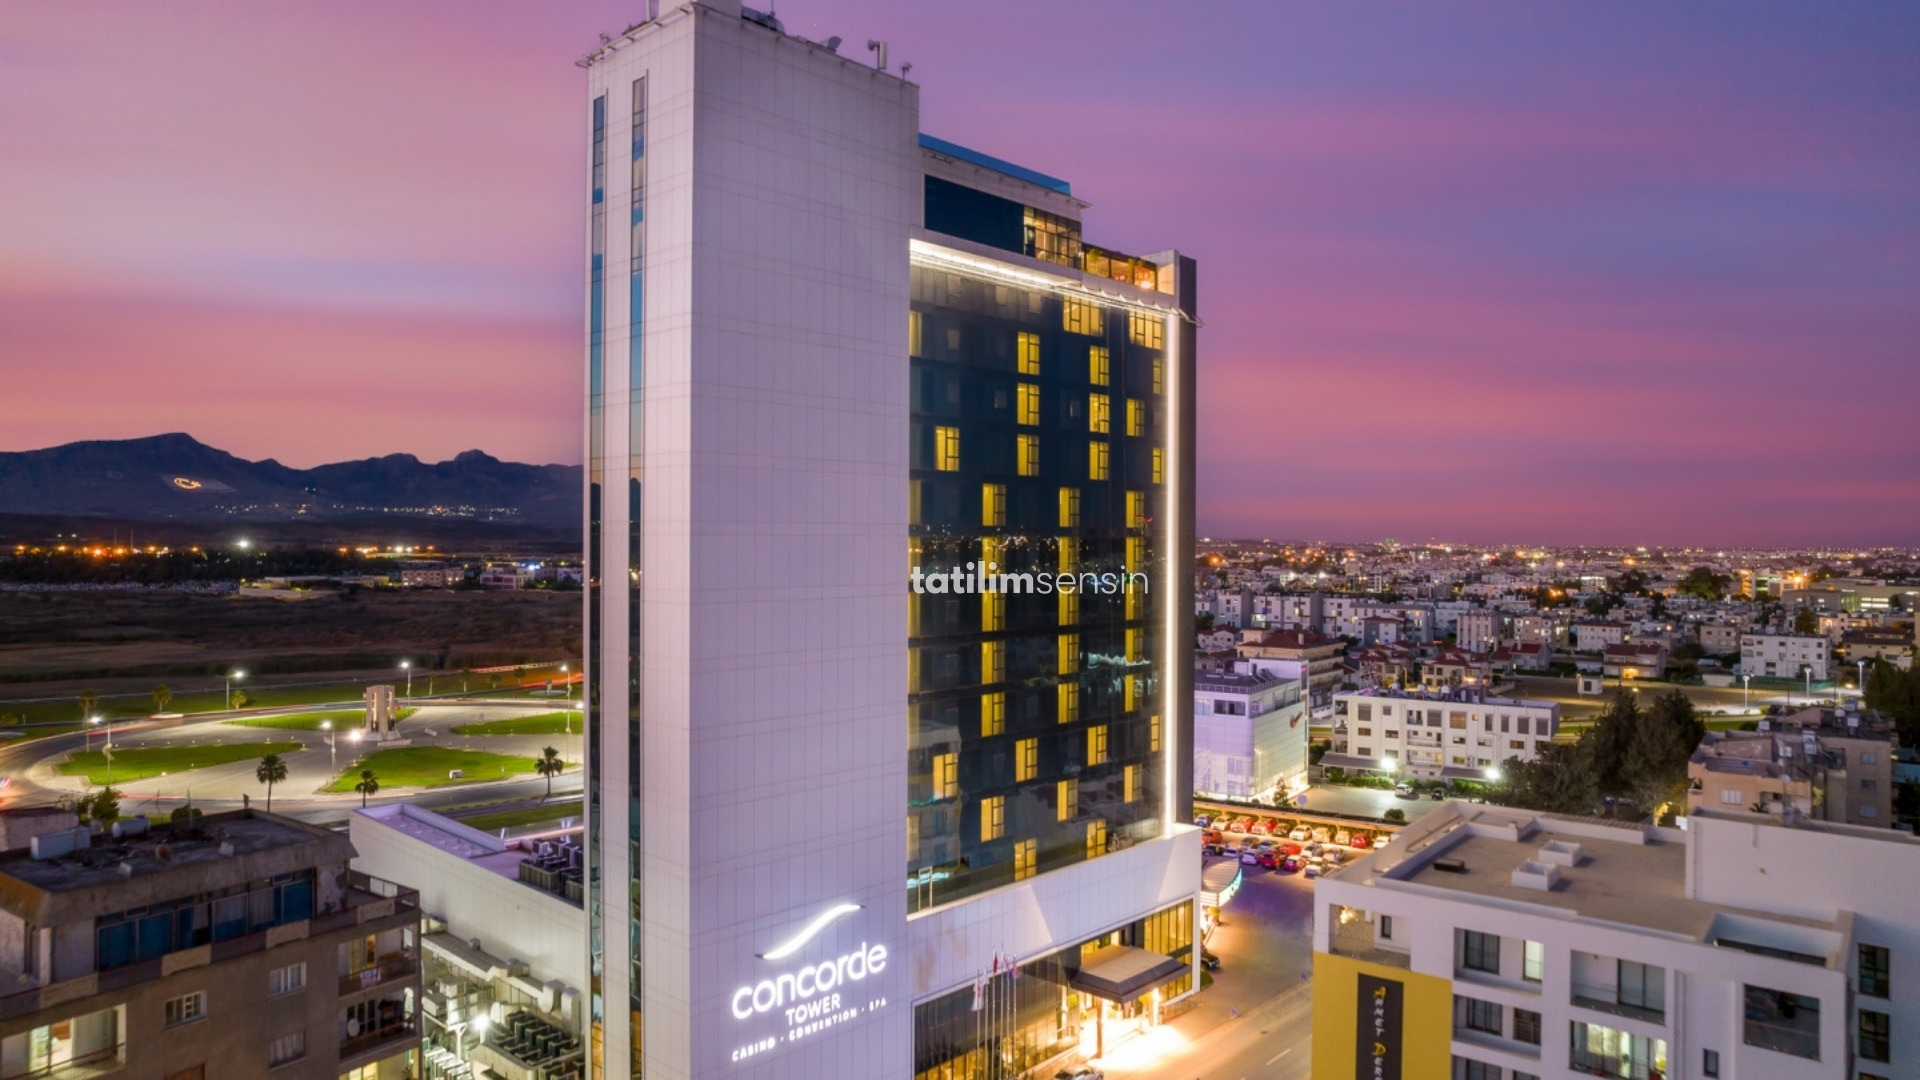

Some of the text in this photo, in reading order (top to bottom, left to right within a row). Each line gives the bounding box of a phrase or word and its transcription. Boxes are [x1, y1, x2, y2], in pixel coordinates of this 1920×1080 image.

[731, 941, 888, 1019] concorde
[784, 993, 842, 1026] TOWER
[731, 997, 887, 1062] CASINO CONVENTION SPA
